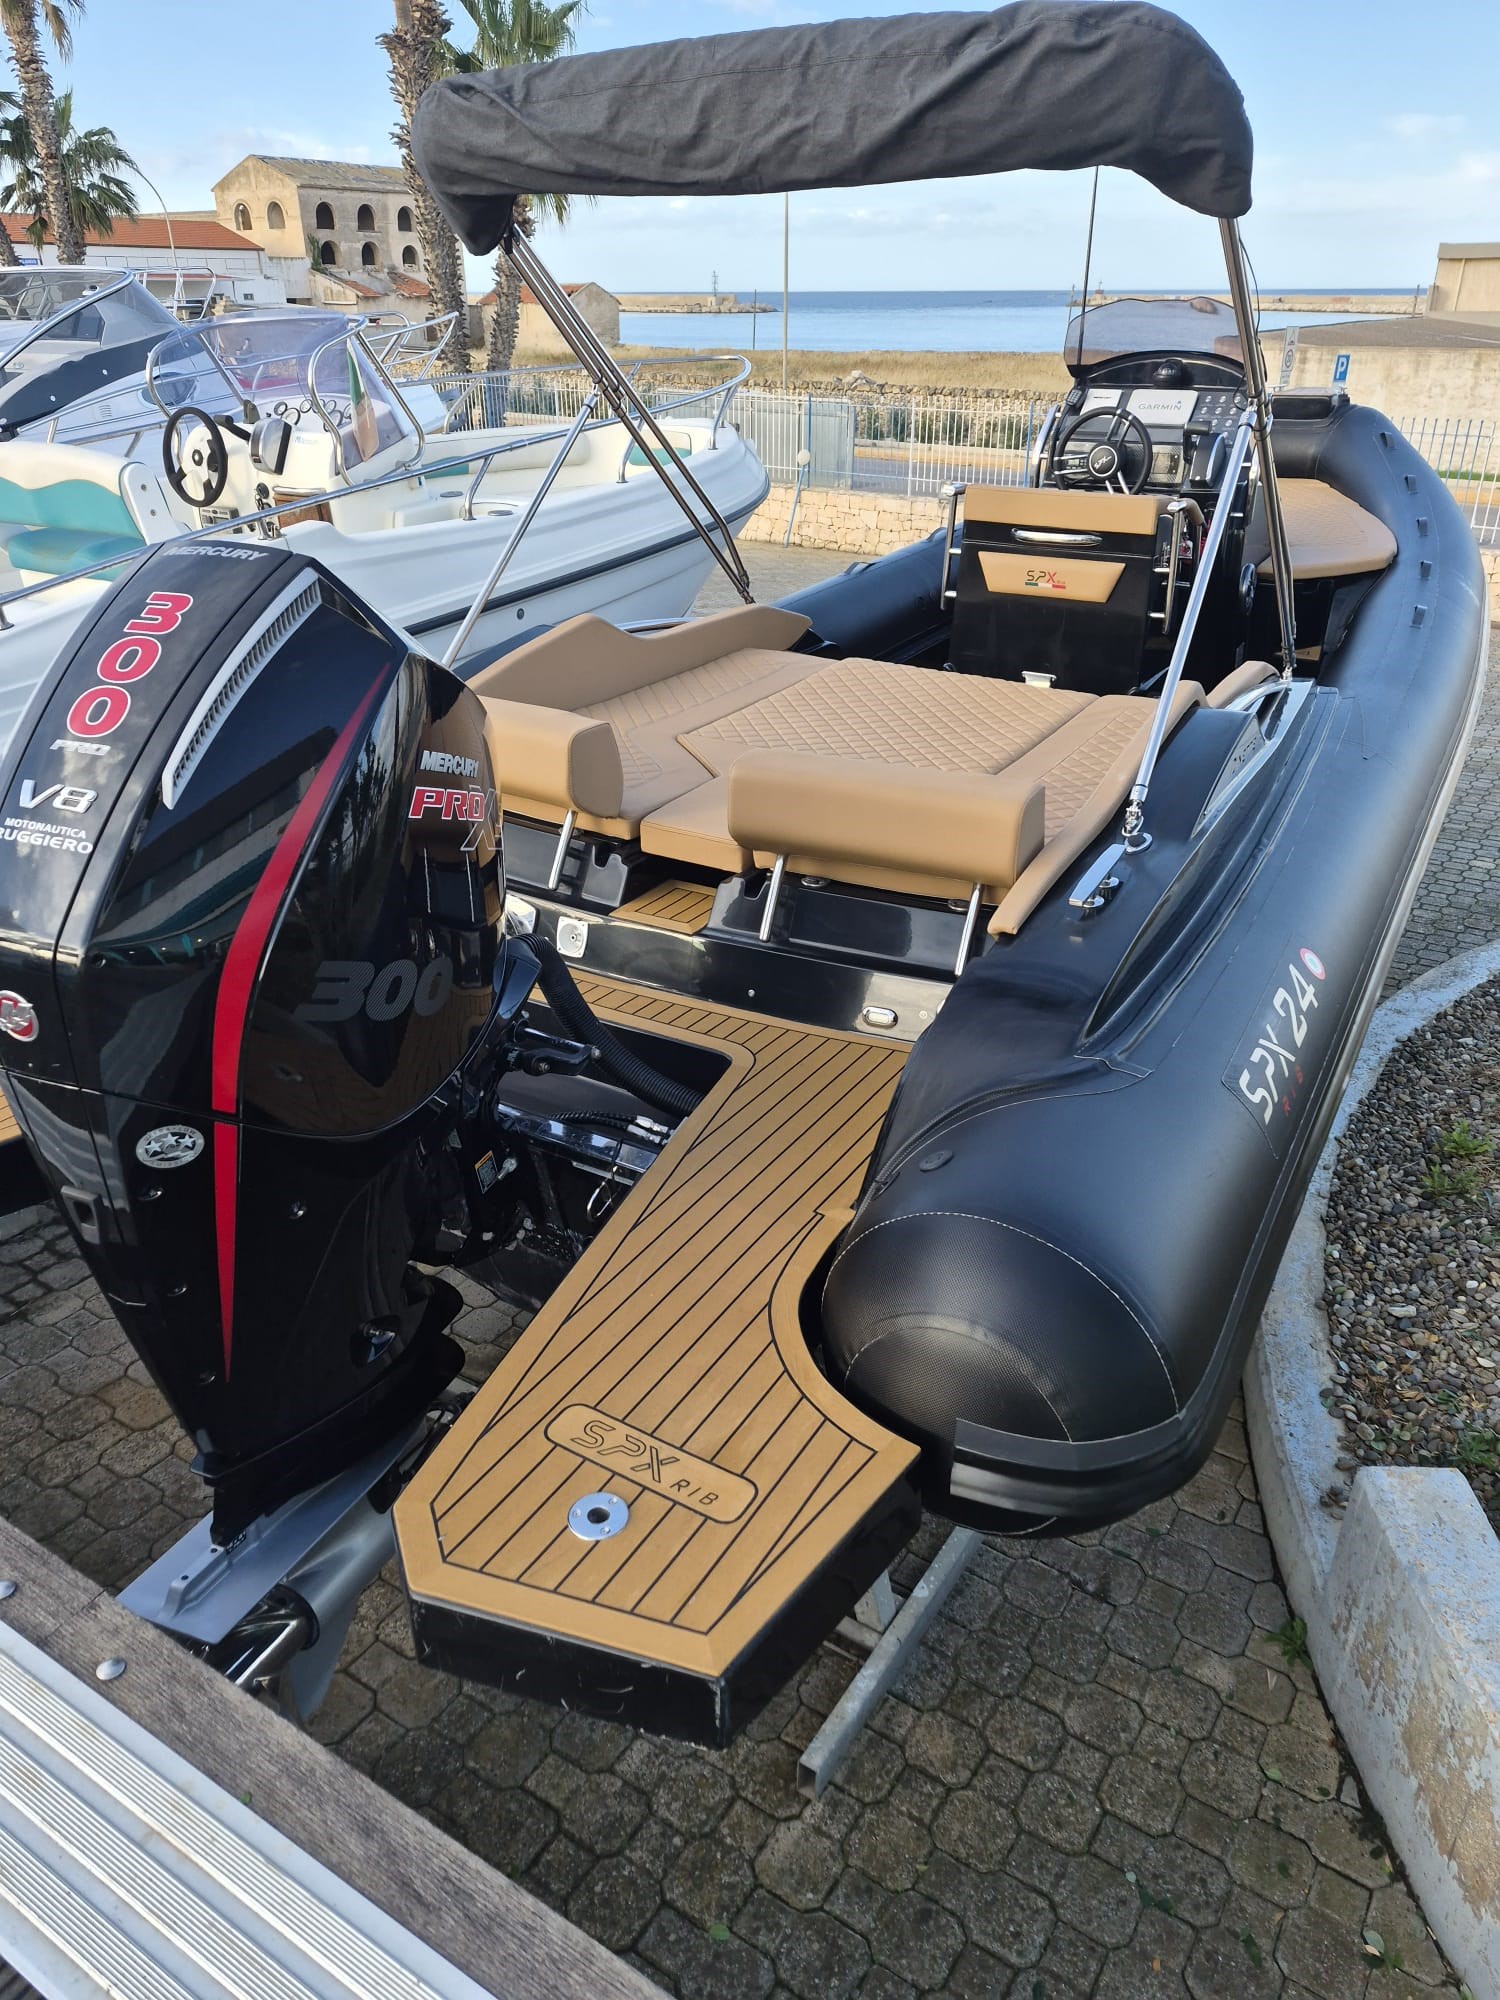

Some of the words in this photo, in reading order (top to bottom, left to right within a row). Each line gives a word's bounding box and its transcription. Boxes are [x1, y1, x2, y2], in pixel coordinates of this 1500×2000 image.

[1335, 357, 1347, 380] P
[1138, 402, 1182, 411] GARMIN
[163, 546, 269, 561] MERCURY
[1026, 570, 1057, 583] SPX
[66, 591, 193, 738] 300
[49, 739, 111, 756] PRO
[420, 750, 479, 778] MERCURY
[19, 779, 98, 814] V8
[408, 786, 485, 822] PRO
[4, 817, 87, 839] MOTONAUTICA
[293, 957, 454, 1022] 300
[1239, 1023, 1296, 1125] SPX
[1273, 963, 1319, 1049] 24
[570, 1420, 680, 1483] SPX
[670, 1478, 719, 1506] RIB
